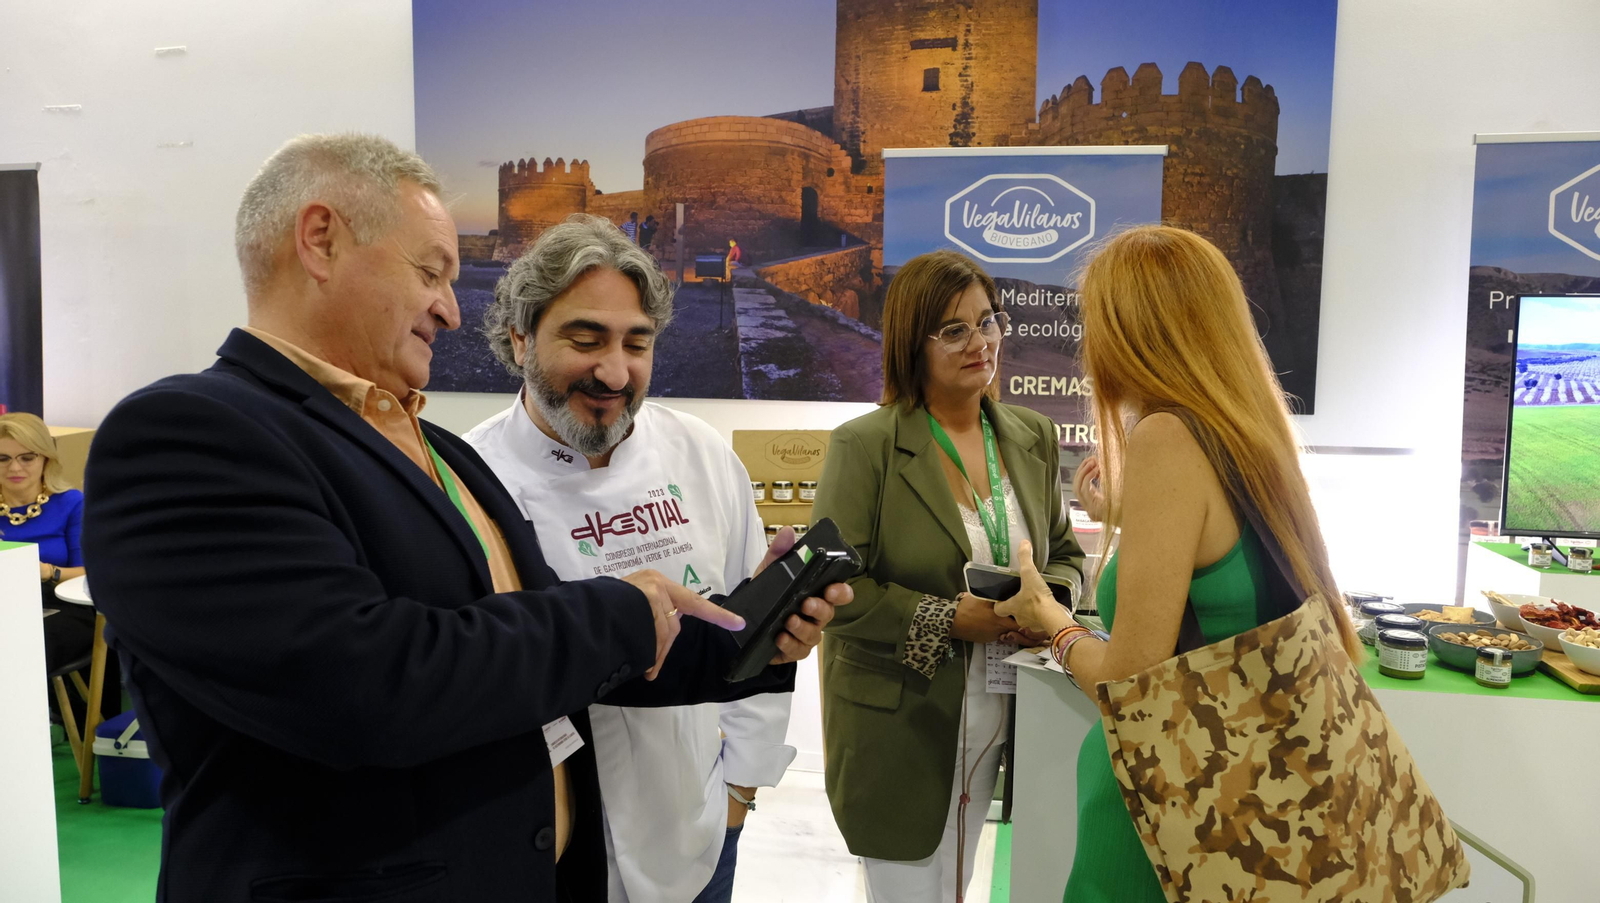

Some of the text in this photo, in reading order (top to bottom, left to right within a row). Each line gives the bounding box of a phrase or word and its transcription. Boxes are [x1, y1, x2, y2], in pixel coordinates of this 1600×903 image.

[962, 200, 1082, 232] VegaVilanos
[989, 232, 1053, 247] BIOVEGANO
[1010, 376, 1093, 396] CREMAS
[772, 444, 821, 460] VegaVilanos
[648, 488, 665, 498] 2023
[593, 542, 694, 575] DE GASTRONOMÍA VERDE DE ALMERÍA
[605, 536, 678, 561] CONGRESO INTERNACIONAL
